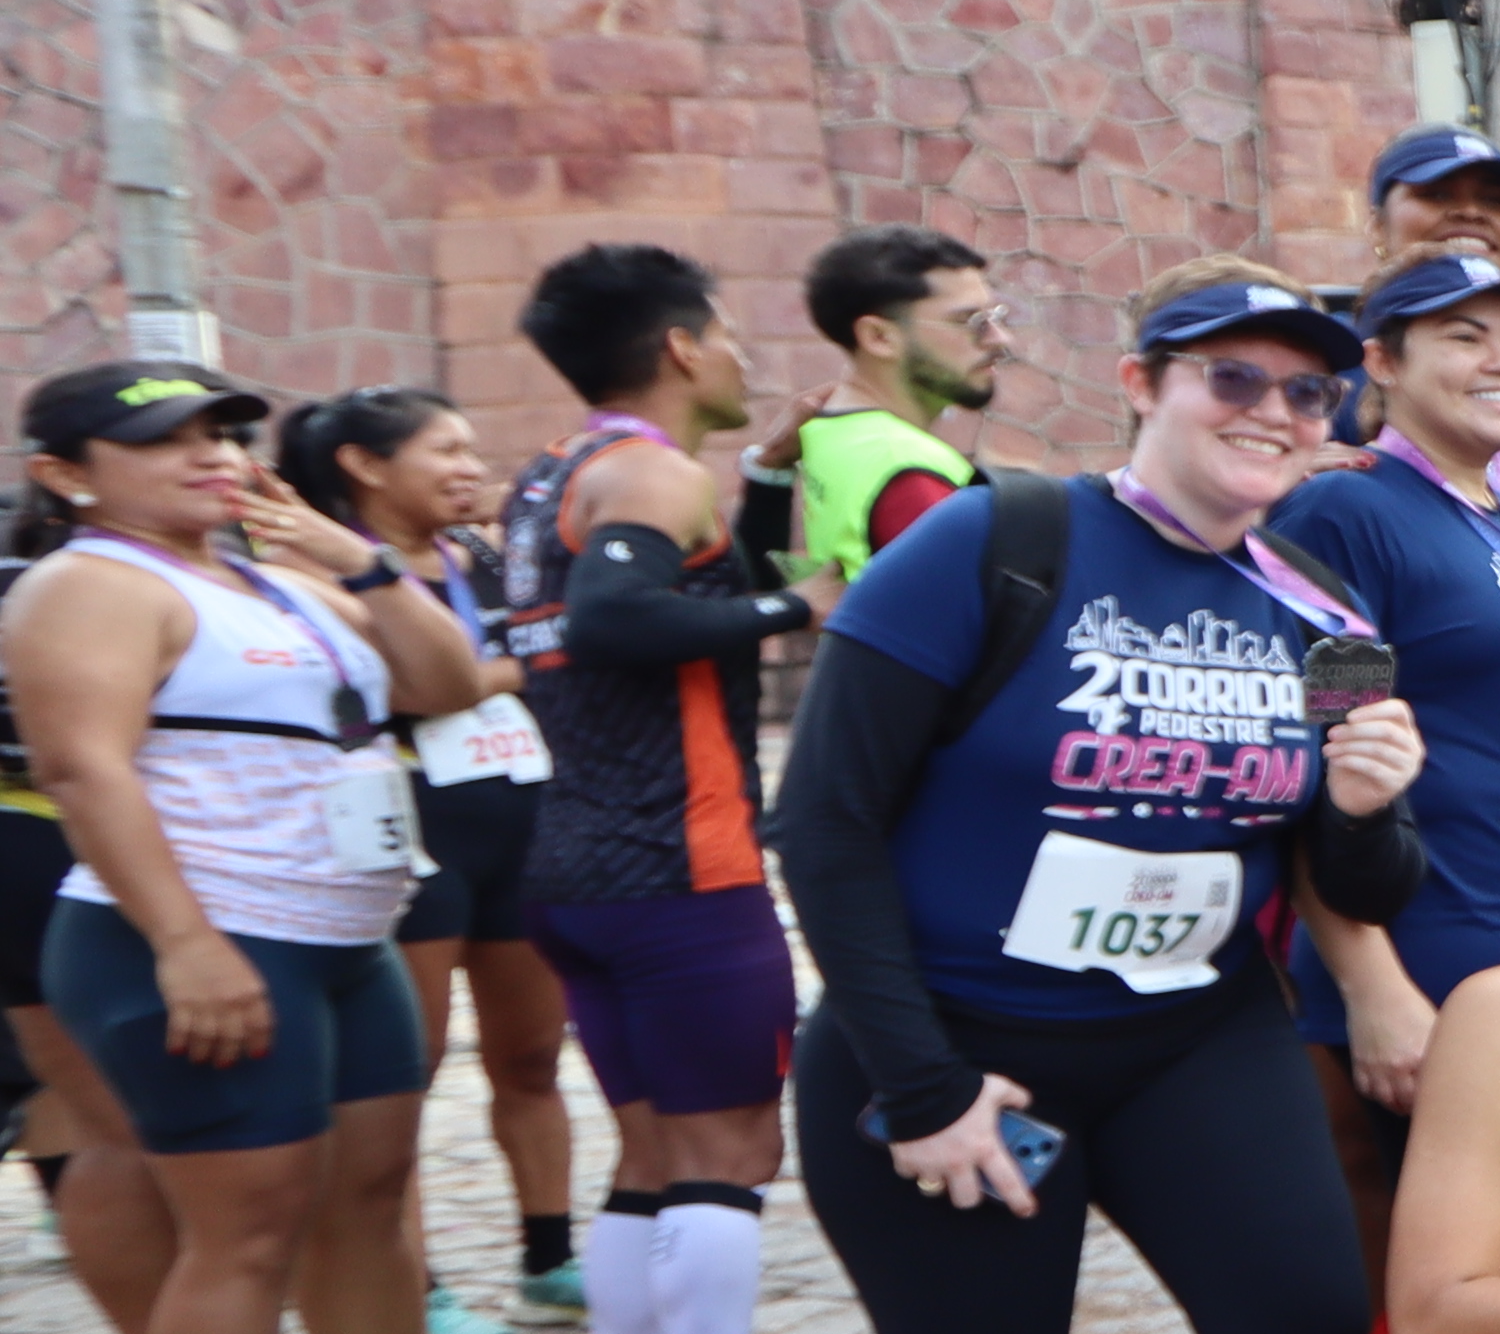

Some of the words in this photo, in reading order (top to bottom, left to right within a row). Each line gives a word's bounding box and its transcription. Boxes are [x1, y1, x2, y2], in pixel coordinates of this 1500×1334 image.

[1120, 657, 1306, 721] CORRIDA
[464, 729, 537, 765] 202
[1139, 708, 1273, 745] PEDESTRE
[1050, 730, 1310, 805] CREA-AM
[1066, 906, 1201, 958] 1037
